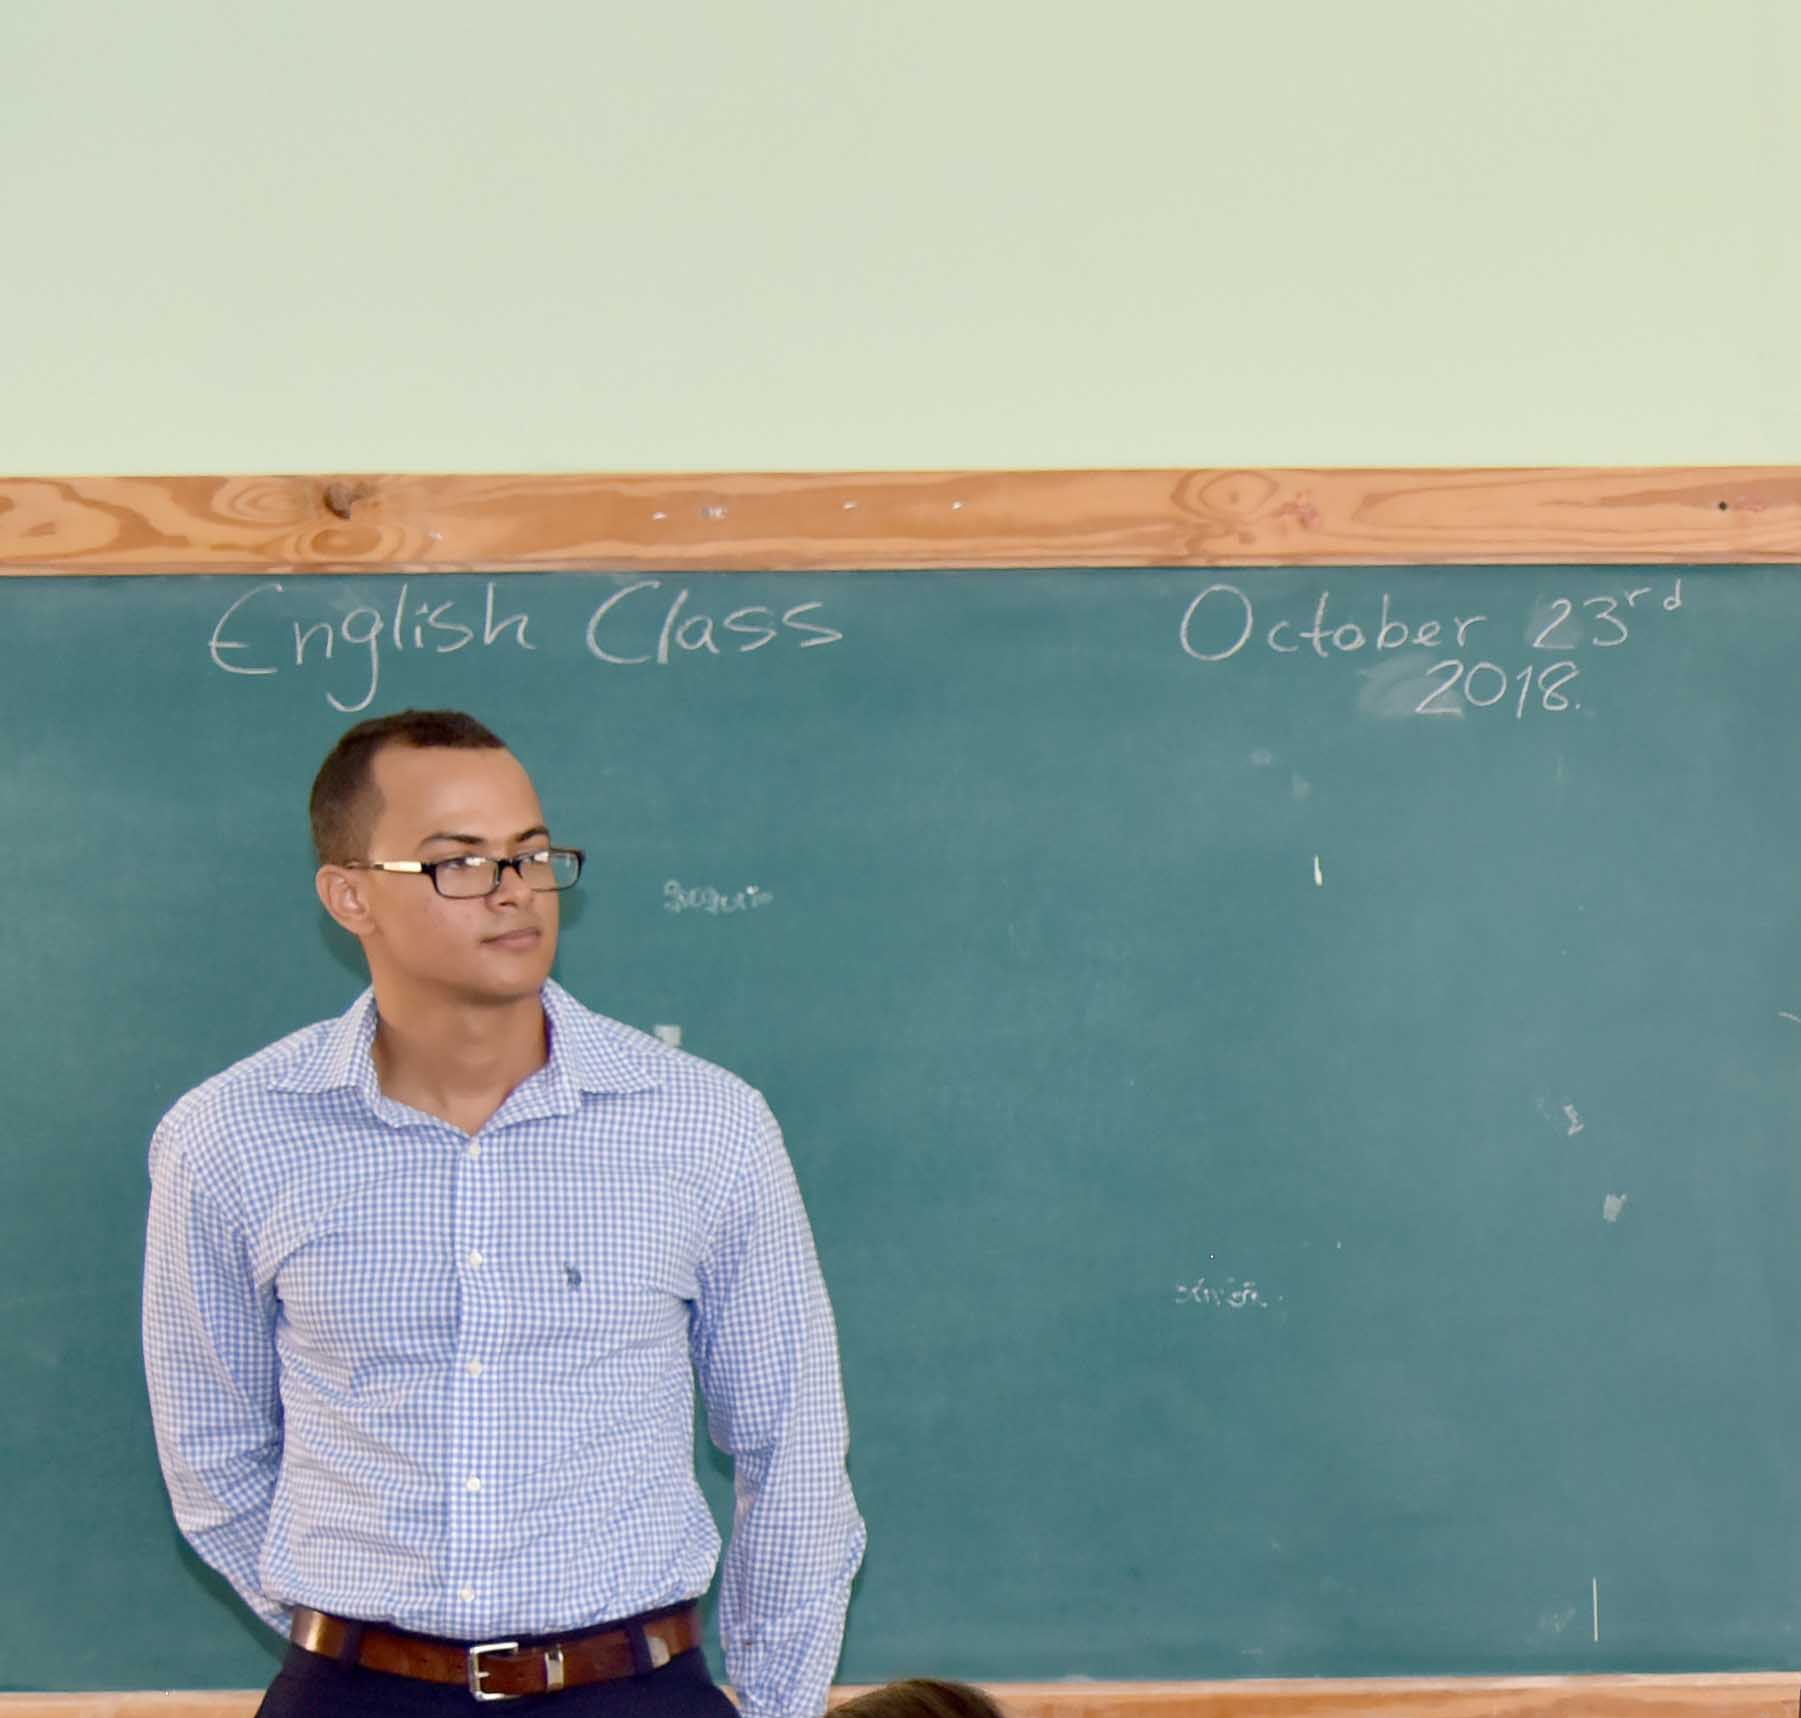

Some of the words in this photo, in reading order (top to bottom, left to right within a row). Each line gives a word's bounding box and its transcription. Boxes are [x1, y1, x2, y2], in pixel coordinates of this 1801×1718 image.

[208, 583, 535, 712] English
[585, 580, 844, 665] Class
[1179, 584, 1487, 661] October
